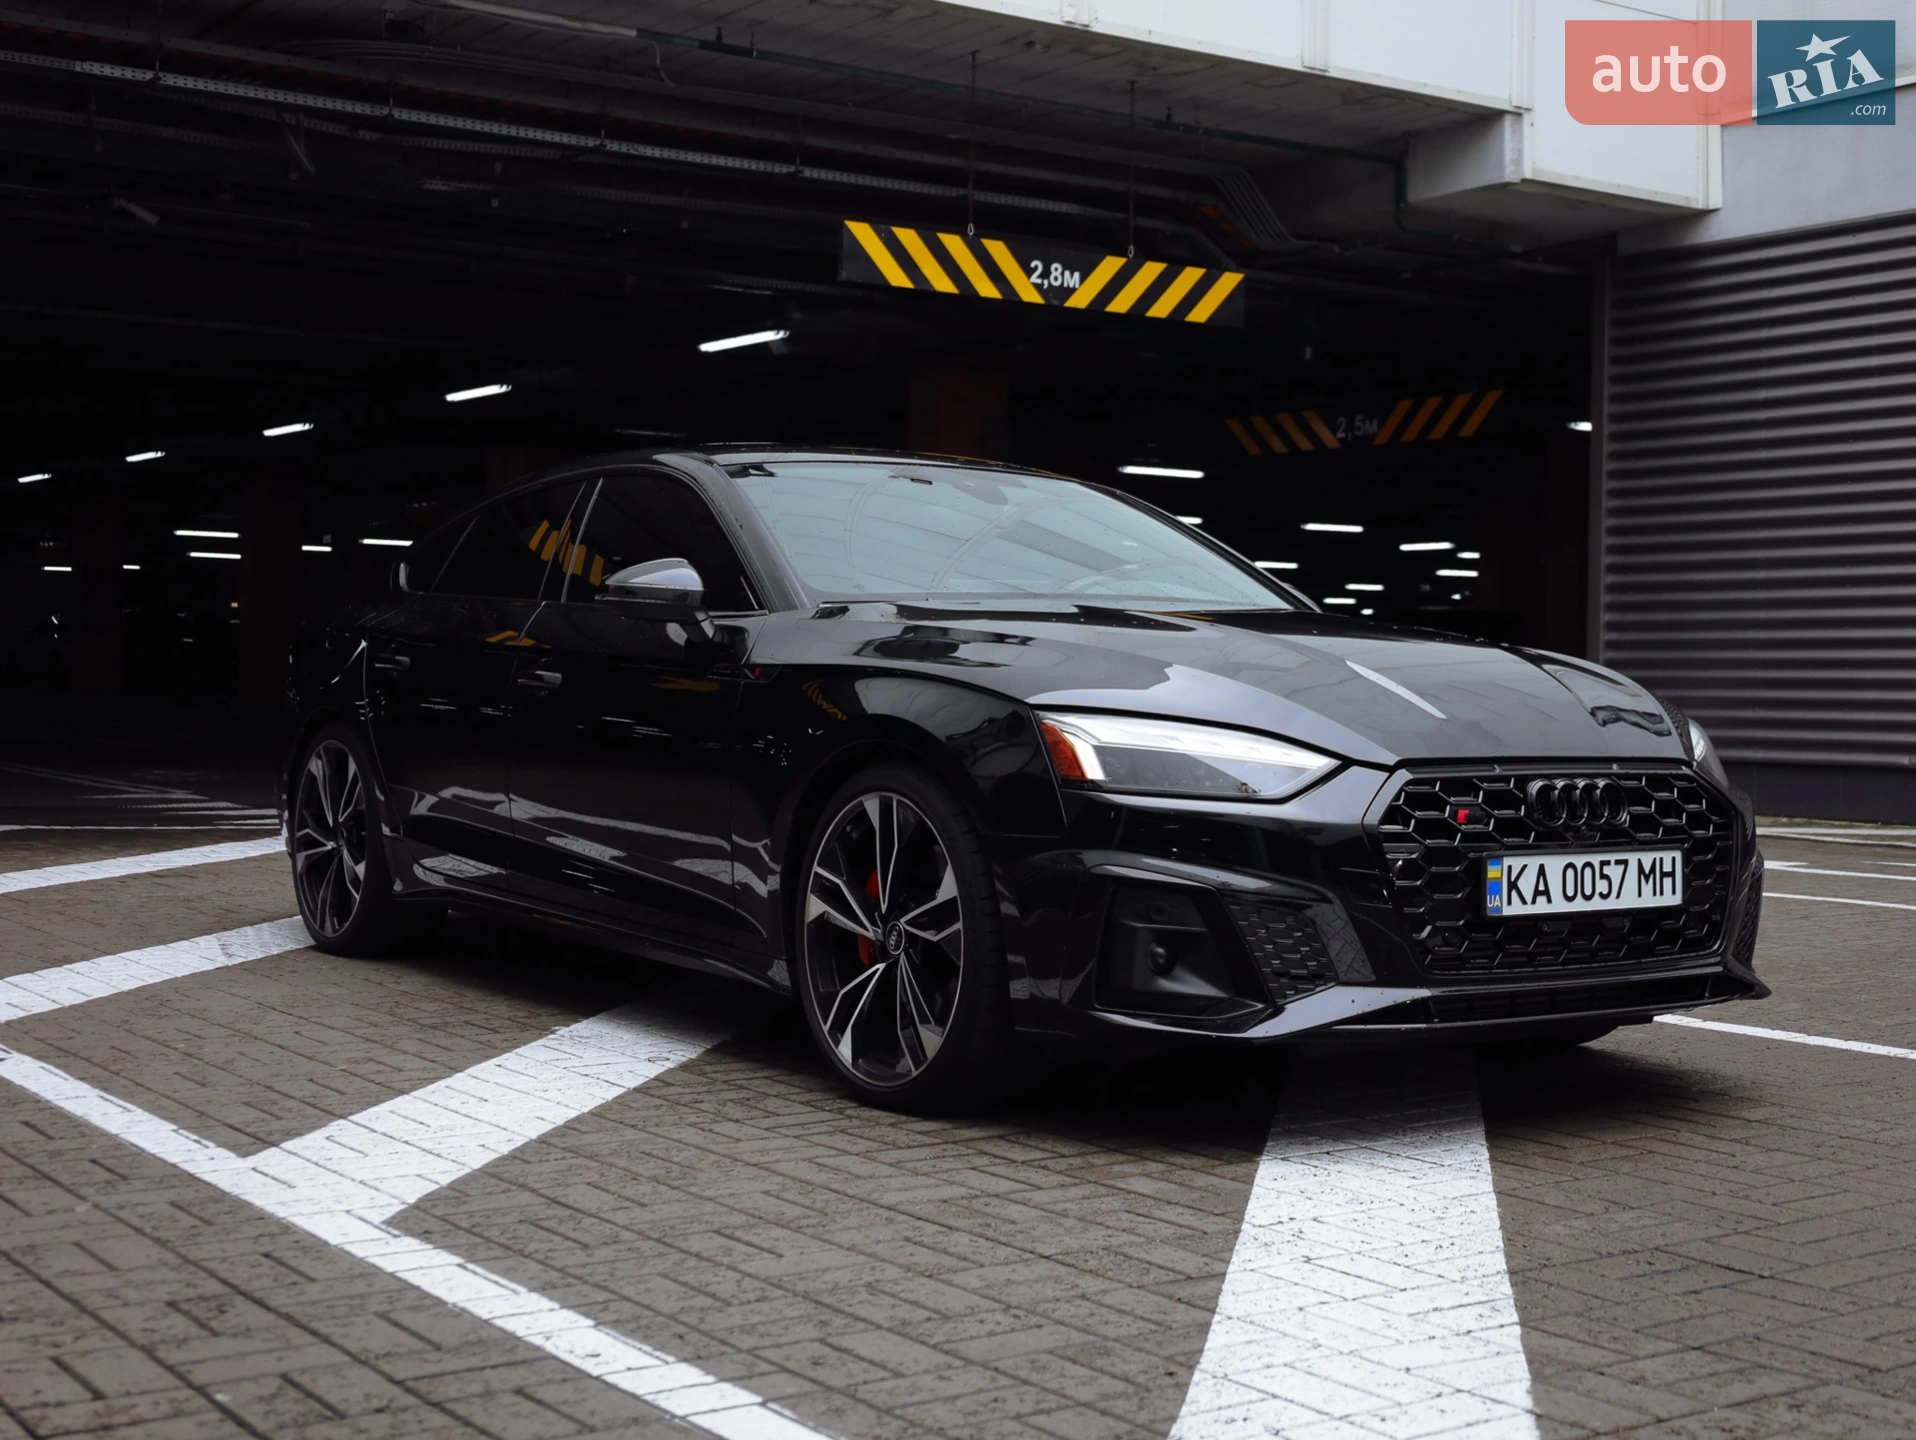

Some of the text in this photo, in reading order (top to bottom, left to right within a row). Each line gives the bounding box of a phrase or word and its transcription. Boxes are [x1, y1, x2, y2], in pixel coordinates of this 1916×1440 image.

[1506, 855, 1677, 907] KA 0057 MH
[1487, 894, 1502, 908] UA
